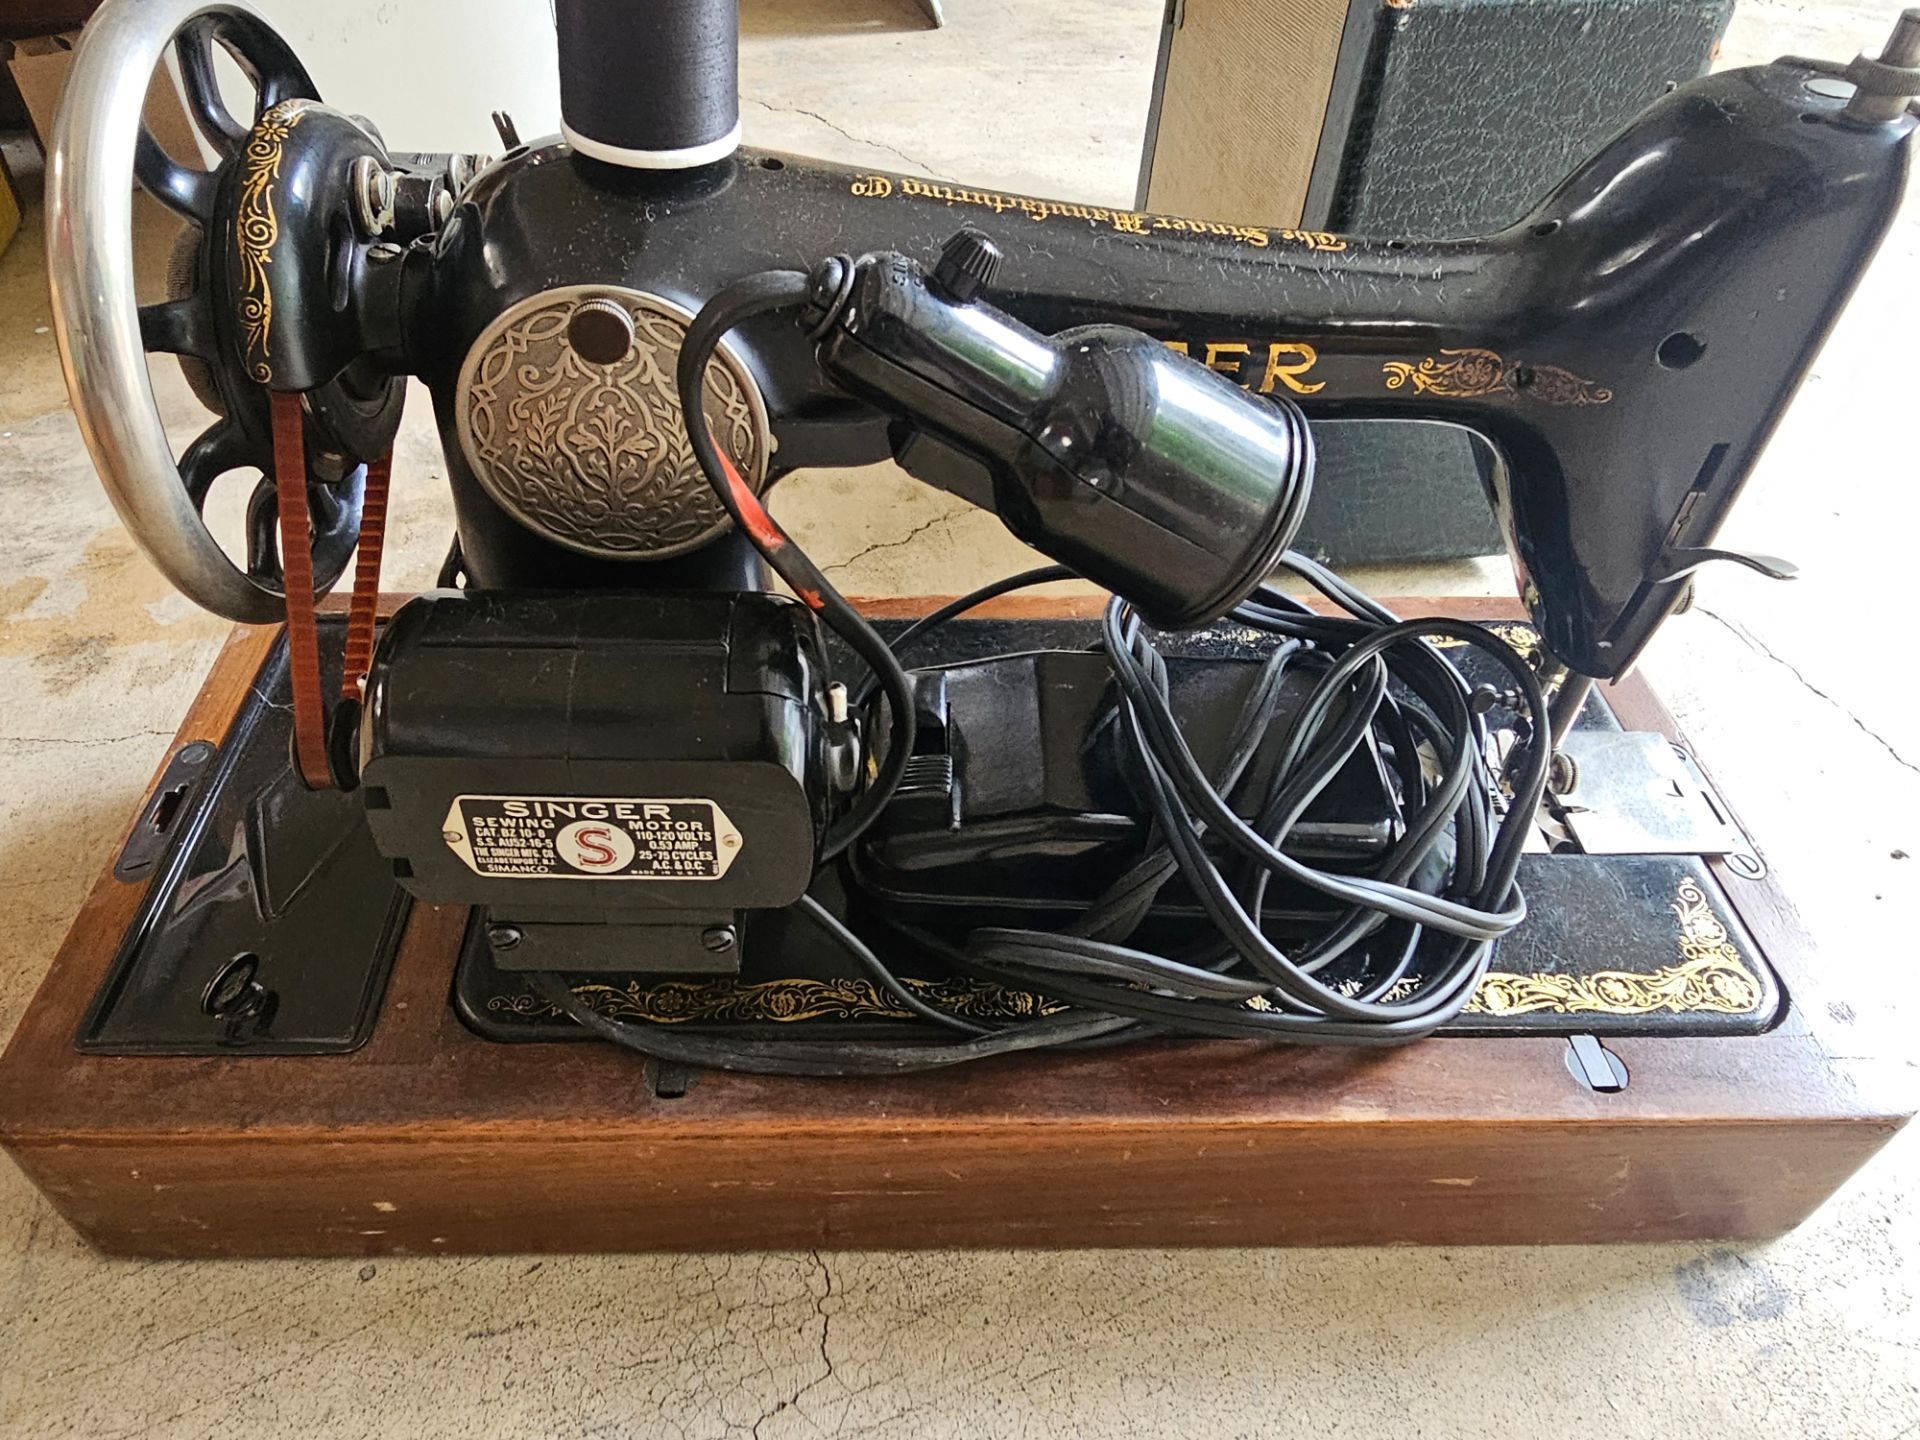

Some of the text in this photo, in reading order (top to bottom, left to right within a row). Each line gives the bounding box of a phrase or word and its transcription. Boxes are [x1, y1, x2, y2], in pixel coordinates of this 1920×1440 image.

[901, 178, 1151, 235] Manufacturing
[1153, 217, 1269, 247] Singer
[1282, 228, 1347, 251] The
[502, 801, 672, 820] SINGER
[472, 816, 556, 829] SEWING
[628, 821, 704, 831] MOTOR
[501, 828, 517, 838] BZ
[636, 831, 712, 841] 110-120 VOLTS
[477, 838, 498, 847] S.S.
[575, 827, 617, 867] S
[649, 841, 673, 850] 0.53
[474, 847, 490, 857] THE
[491, 848, 520, 858] SINGER
[672, 851, 714, 861] CYCLES
[652, 860, 673, 870] A.C.
[674, 861, 683, 870] &
[684, 861, 706, 870] D.C.
